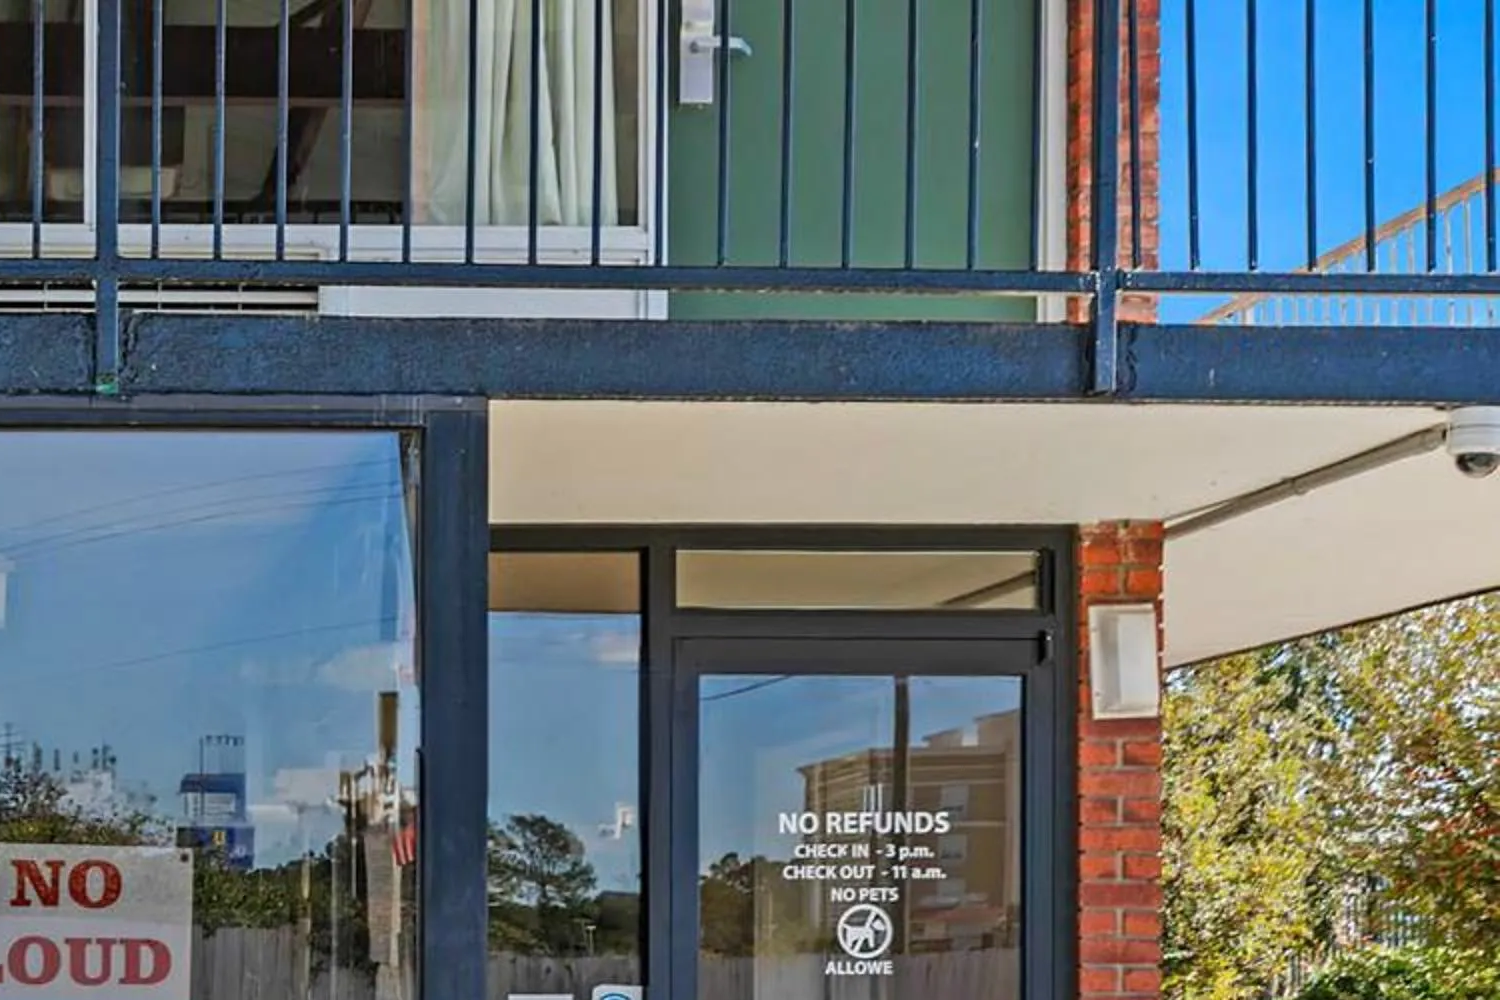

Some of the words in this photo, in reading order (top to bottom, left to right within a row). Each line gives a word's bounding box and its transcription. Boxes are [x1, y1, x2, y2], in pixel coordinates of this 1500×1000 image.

[779, 812, 819, 834] NO
[826, 811, 950, 834] REFUNDS
[794, 844, 847, 858] CHECK
[852, 844, 869, 858] IN
[885, 844, 895, 858] 3
[899, 847, 935, 862] p.m.
[783, 866, 836, 880] CHECK
[839, 866, 875, 880] OUT
[892, 866, 908, 879] 11
[912, 868, 947, 880] a.m.
[9, 859, 122, 909] NO
[831, 888, 856, 902] NO
[859, 888, 899, 902] PETS
[825, 961, 893, 975] ALLOWE
